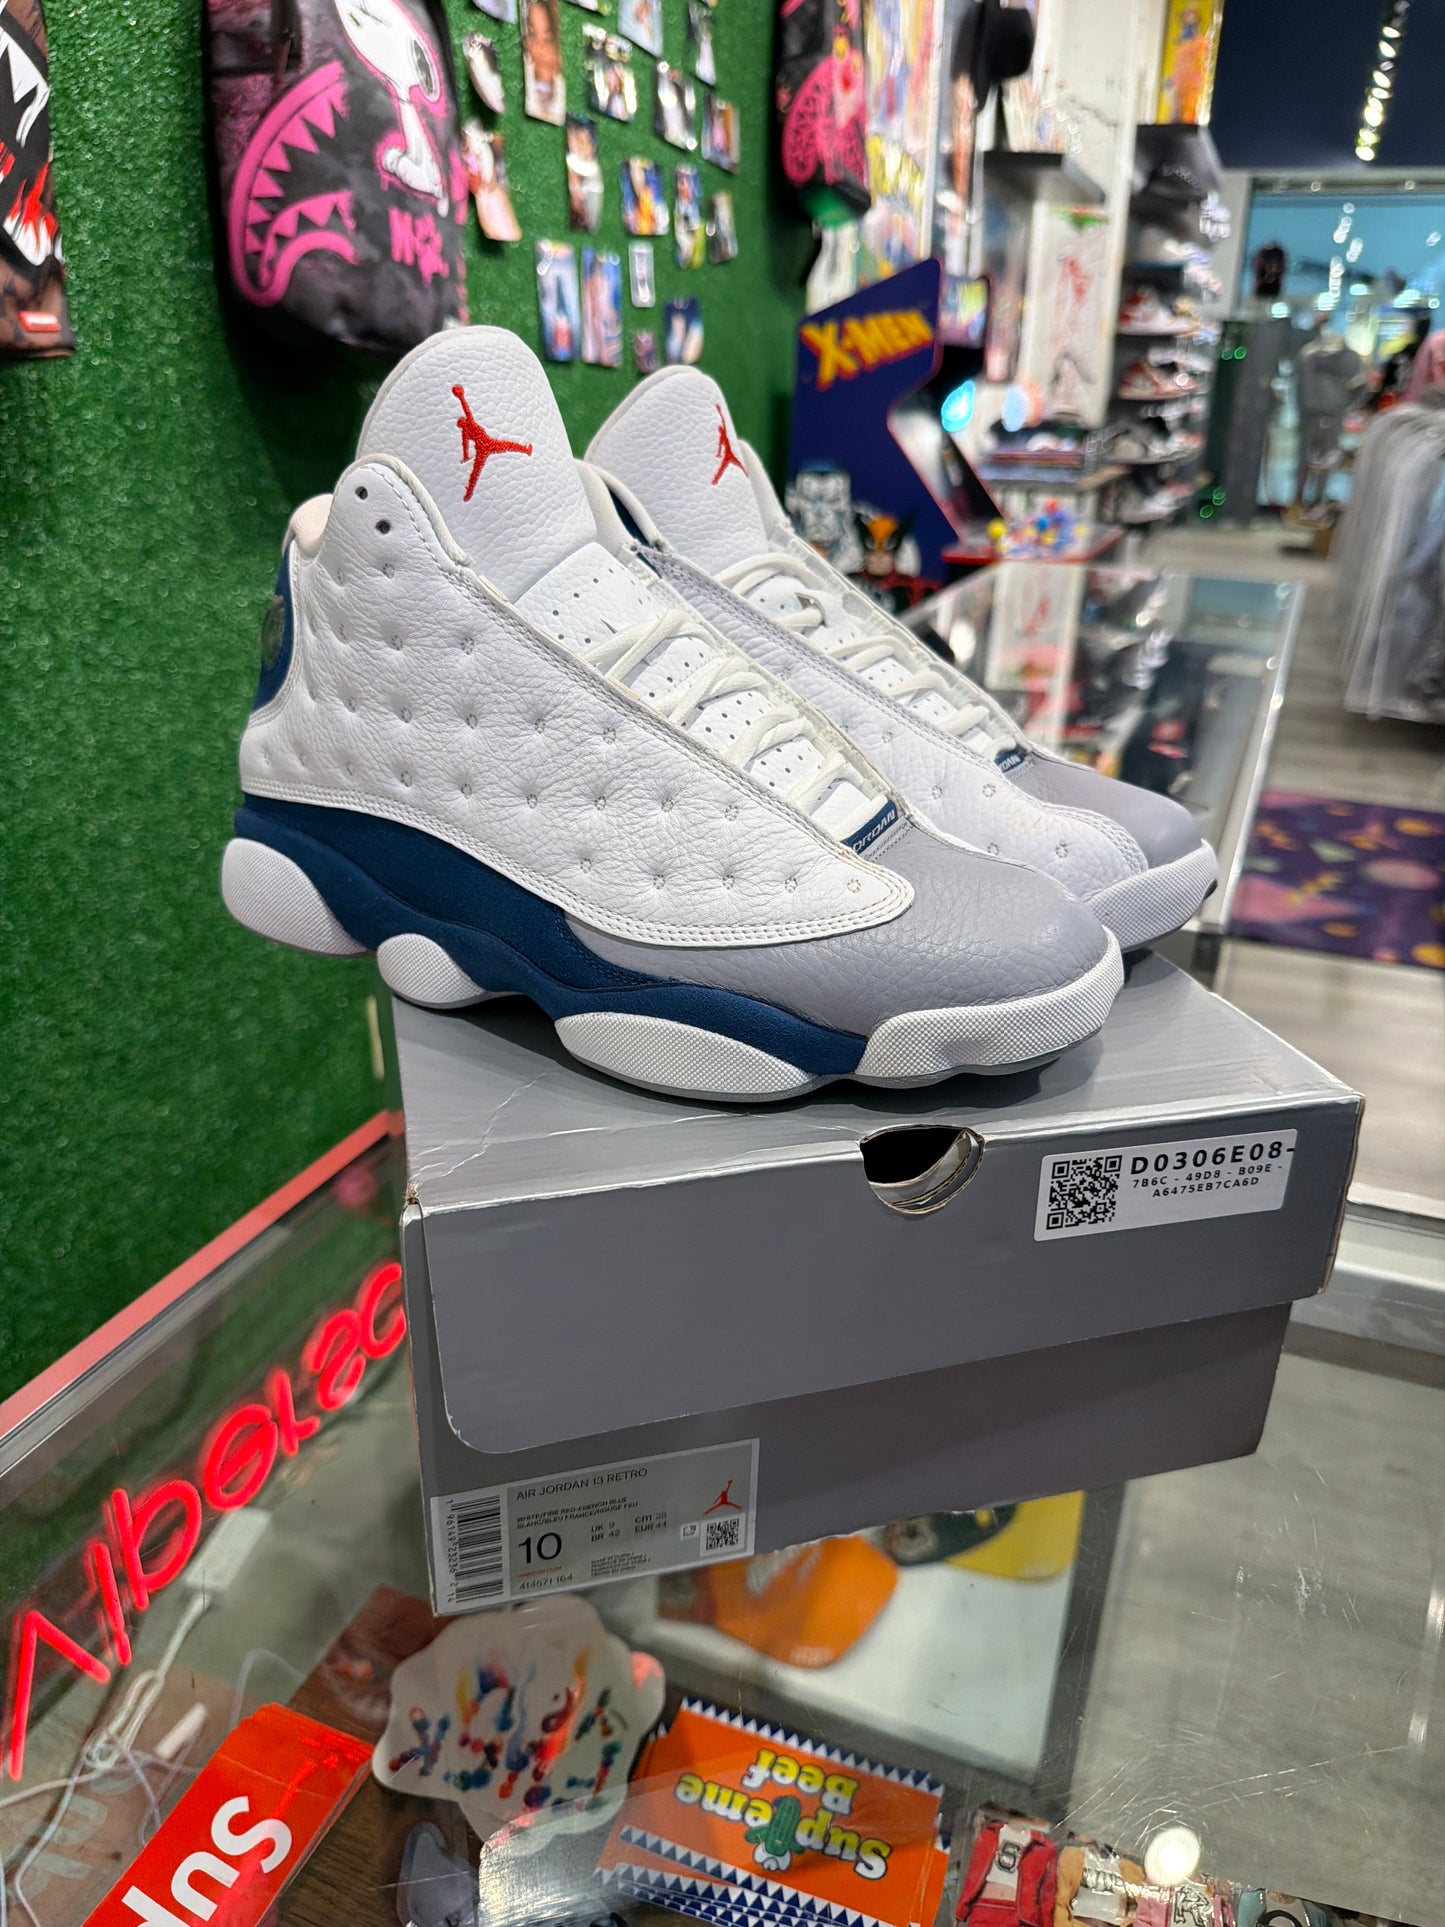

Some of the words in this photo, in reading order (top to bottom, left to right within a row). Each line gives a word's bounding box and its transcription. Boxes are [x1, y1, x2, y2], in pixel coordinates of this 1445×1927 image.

[799, 310, 934, 392] X-MEN
[1001, 754, 1021, 769] DAN
[852, 808, 896, 852] ORDAN
[1152, 1177, 1259, 1198] A6475EB7CA6D
[516, 1488, 536, 1501] AIR
[539, 1479, 589, 1496] JORDAN
[593, 1475, 605, 1486] 13
[606, 1467, 648, 1483] RETRO
[609, 1496, 627, 1504] BLUE
[591, 1523, 604, 1533] UK
[634, 1514, 652, 1524] cm
[634, 1523, 654, 1533] EUR
[655, 1521, 667, 1531] 44
[518, 1532, 562, 1564] 10
[740, 1747, 861, 1818] Beef
[673, 1772, 892, 1882] Supeme
